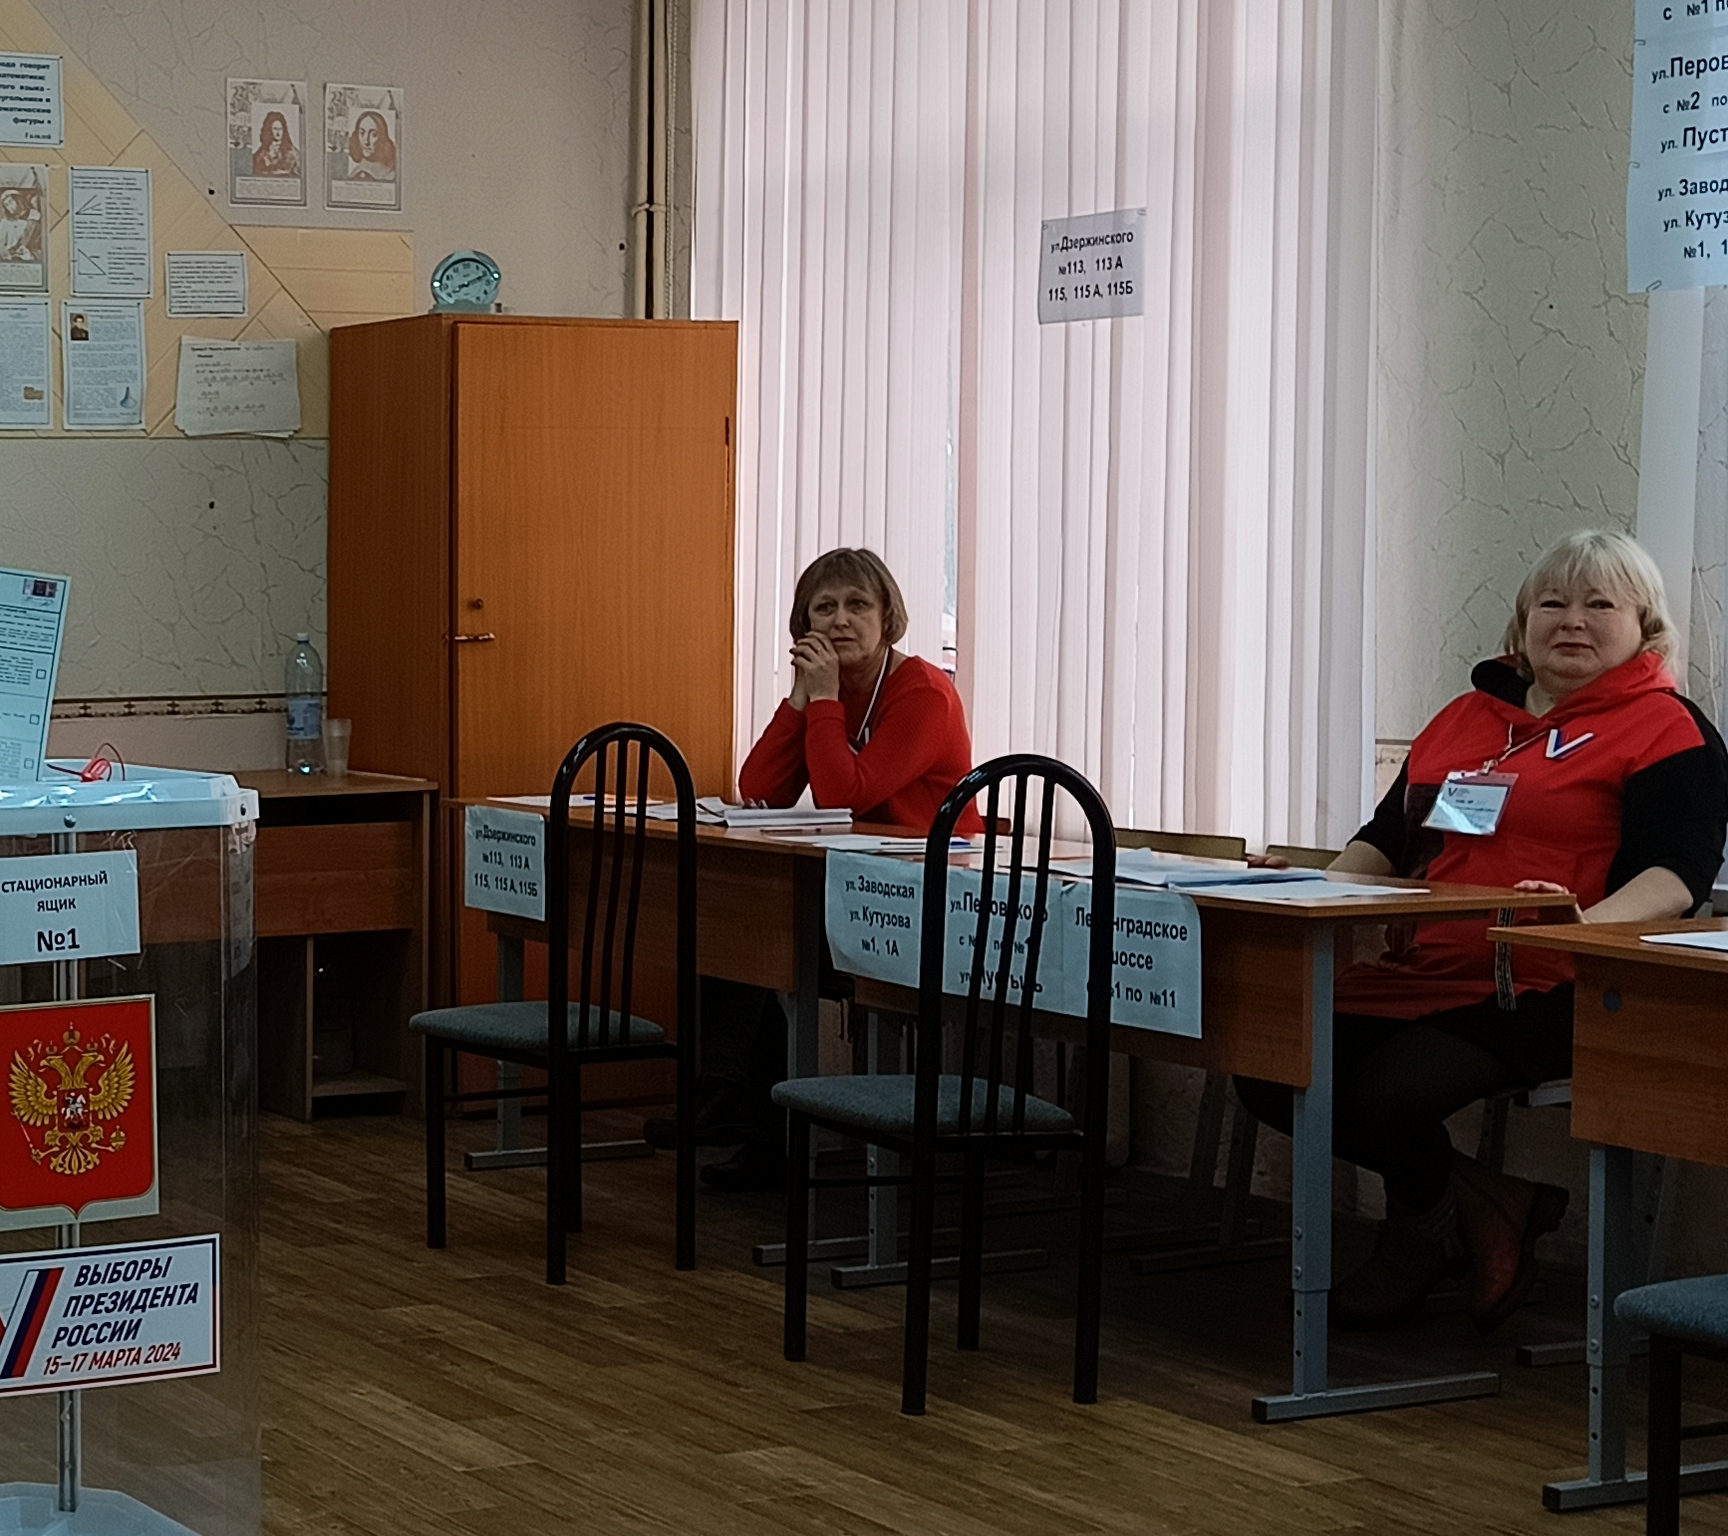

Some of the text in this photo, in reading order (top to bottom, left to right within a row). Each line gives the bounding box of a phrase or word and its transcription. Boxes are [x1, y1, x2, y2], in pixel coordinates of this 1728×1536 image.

[1663, 6, 1673, 20] с
[1662, 103, 1670, 114] с
[1676, 91, 1700, 112] №2
[1, 870, 108, 893] СТАЦИОНАРНЫЙ
[858, 875, 915, 899] Заводская
[37, 898, 77, 912] ЯЩИК
[862, 905, 911, 929] Кутузова
[1075, 906, 1188, 941] Ленградское
[37, 928, 80, 952] №1
[885, 938, 900, 957] 1А
[1125, 986, 1143, 1002] по
[1149, 989, 1176, 1008] №11
[73, 1256, 173, 1287] ВЫБОРЫ
[62, 1282, 200, 1318] ПРЕЗИДЕНТА
[51, 1318, 143, 1349] РОССИИ
[88, 1345, 143, 1371] МАРТА
[143, 1342, 182, 1364] 2024
